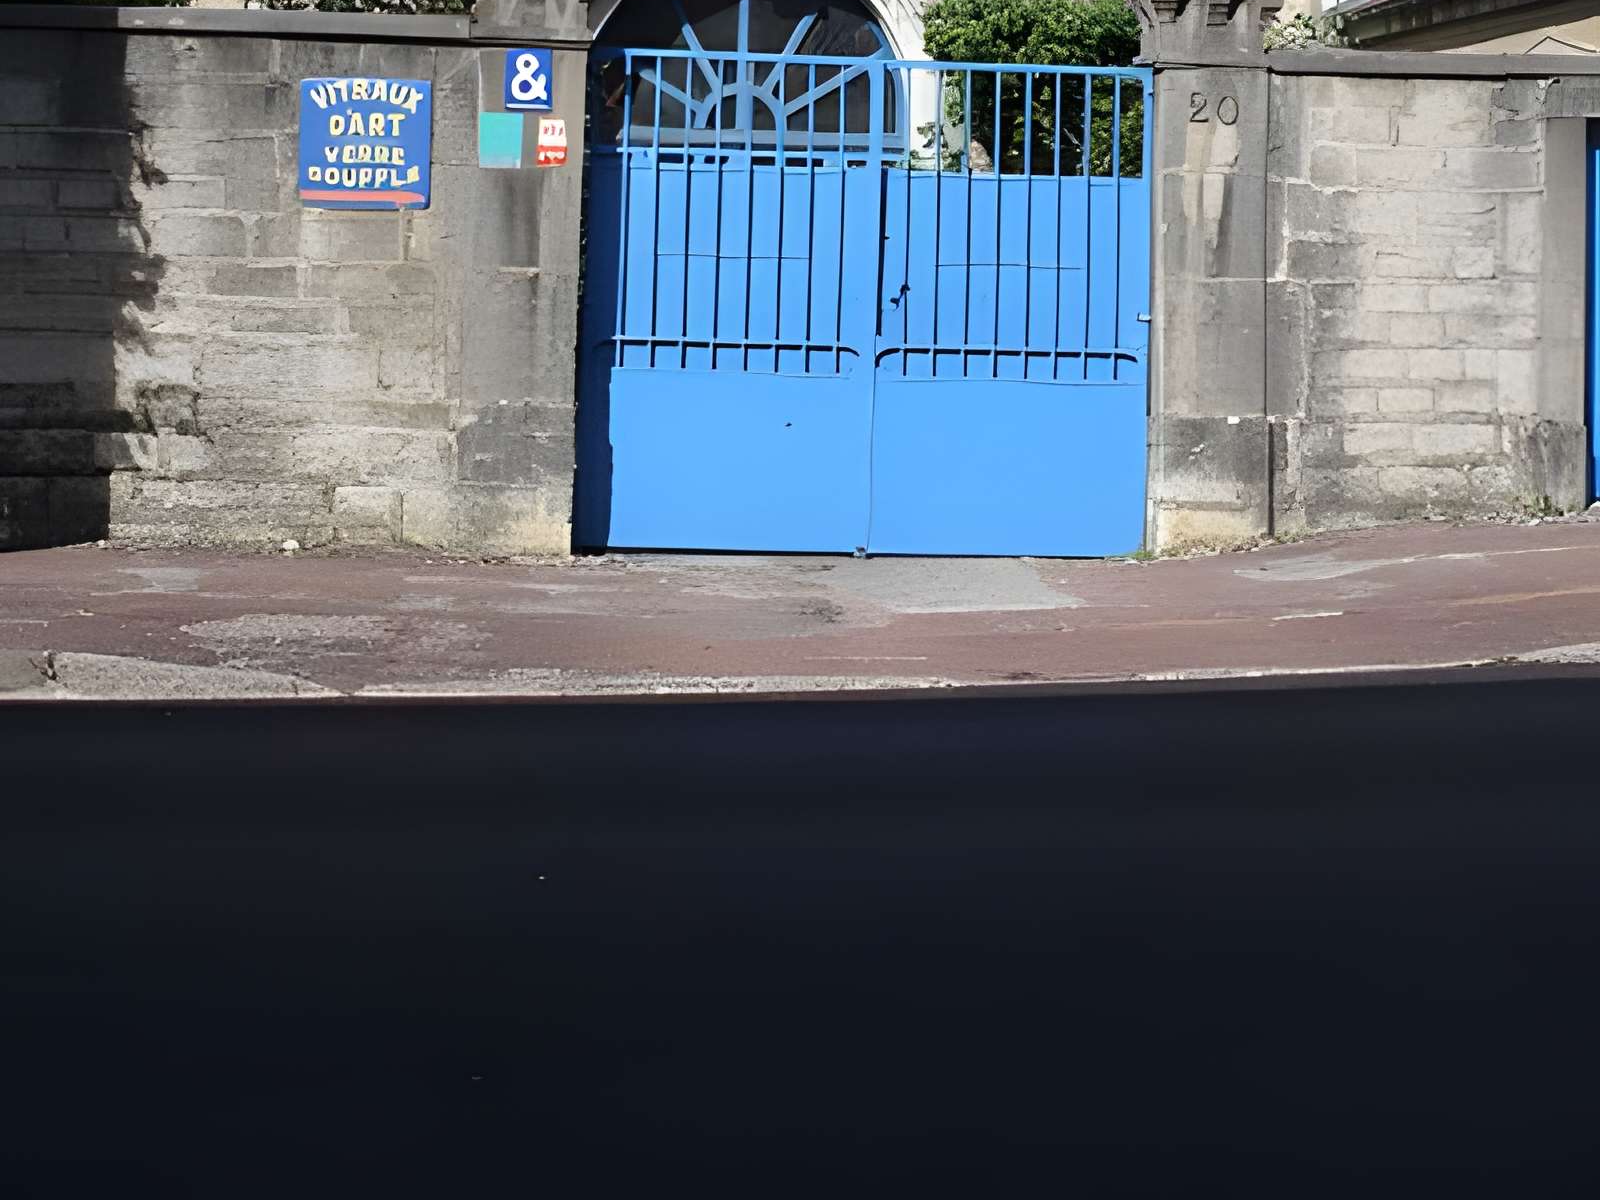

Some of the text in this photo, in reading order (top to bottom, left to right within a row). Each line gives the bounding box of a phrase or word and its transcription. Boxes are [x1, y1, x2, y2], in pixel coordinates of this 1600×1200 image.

[511, 53, 547, 100] &
[310, 79, 423, 114] VITRAUX
[1190, 92, 1239, 126] 20
